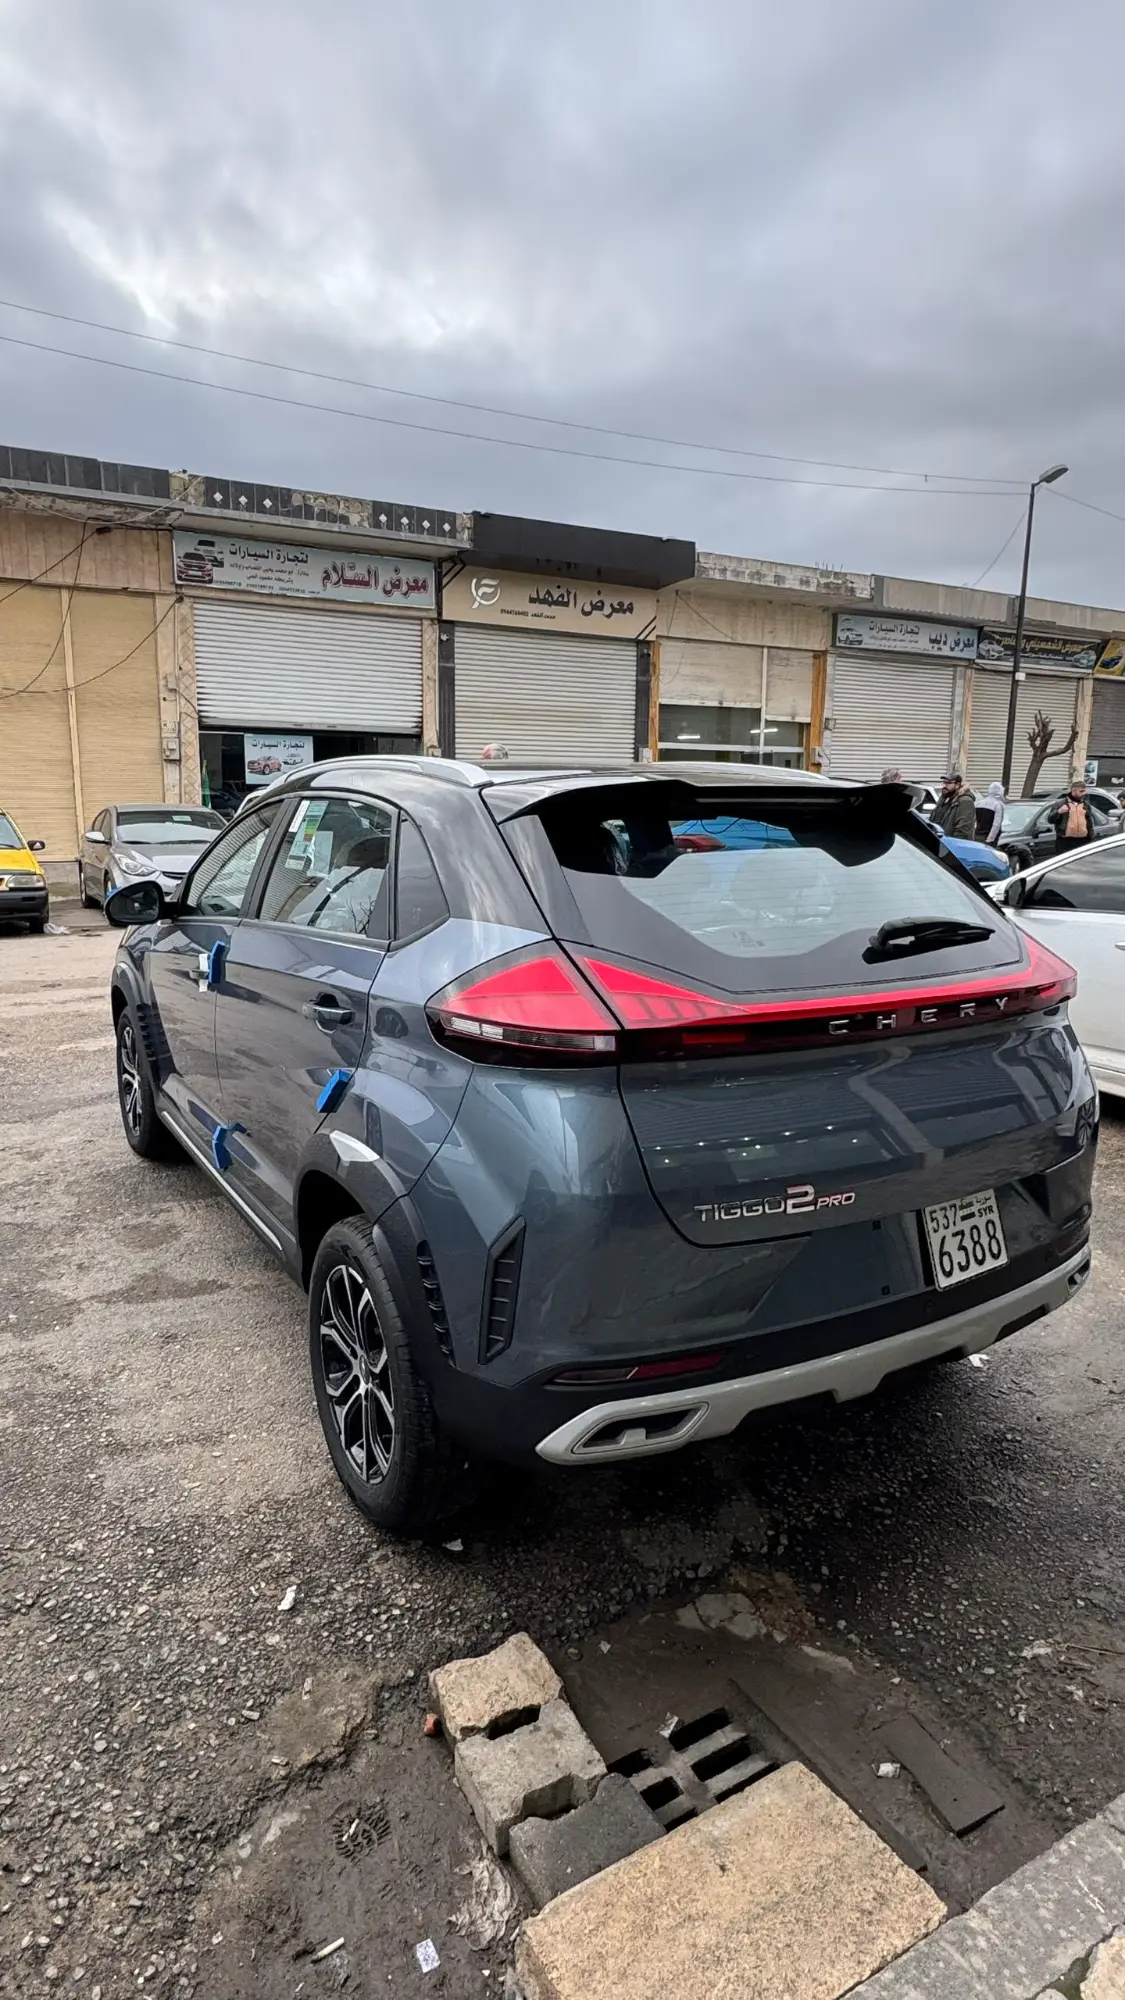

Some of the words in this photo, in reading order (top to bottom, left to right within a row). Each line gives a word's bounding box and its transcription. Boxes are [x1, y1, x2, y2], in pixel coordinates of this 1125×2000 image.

[229, 543, 273, 561] السيارات
[275, 548, 308, 566] لتجارة
[382, 564, 428, 598] معرض
[528, 585, 577, 610] الفهد
[581, 590, 634, 619] معرض
[869, 621, 899, 634] السيارات
[900, 624, 920, 638] لتجارة
[928, 632, 948, 651] ديب
[950, 632, 974, 653] معرض
[252, 739, 281, 750] السيارات
[283, 740, 305, 750] لتجارة
[828, 997, 1008, 1035] CHERY
[929, 1203, 957, 1234] 537
[977, 1205, 994, 1218] SYR
[939, 1219, 1002, 1279] 6388
